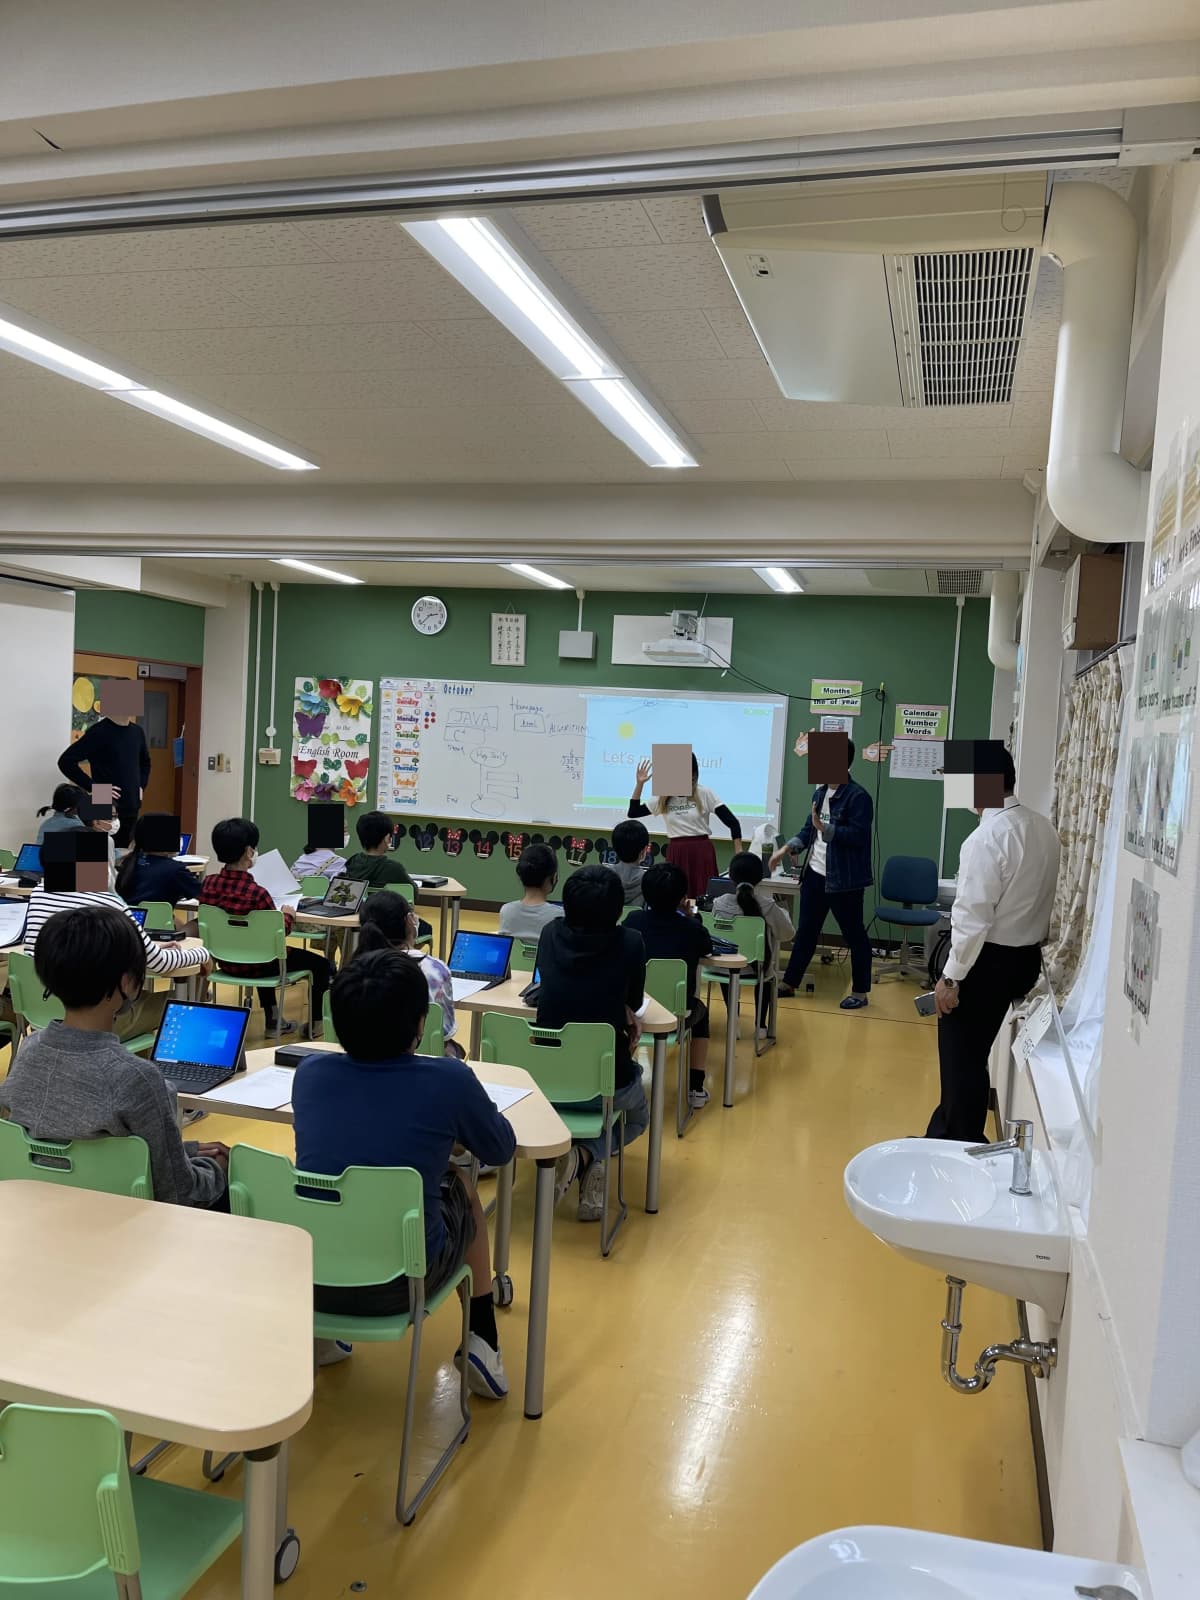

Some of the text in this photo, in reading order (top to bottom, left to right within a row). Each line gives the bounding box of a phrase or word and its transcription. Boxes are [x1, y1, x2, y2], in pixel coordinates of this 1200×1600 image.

[443, 683, 473, 695] October
[823, 687, 851, 695] Months
[454, 711, 490, 727] JAVA
[903, 709, 938, 717] Calendar
[904, 719, 938, 727] Number
[906, 727, 932, 735] Words
[299, 746, 359, 759] English Room
[603, 751, 634, 765] Let's
[446, 839, 461, 852] 13
[476, 841, 490, 853] 14
[508, 843, 522, 857] 15
[570, 848, 585, 862] 17
[602, 849, 617, 864] 18
